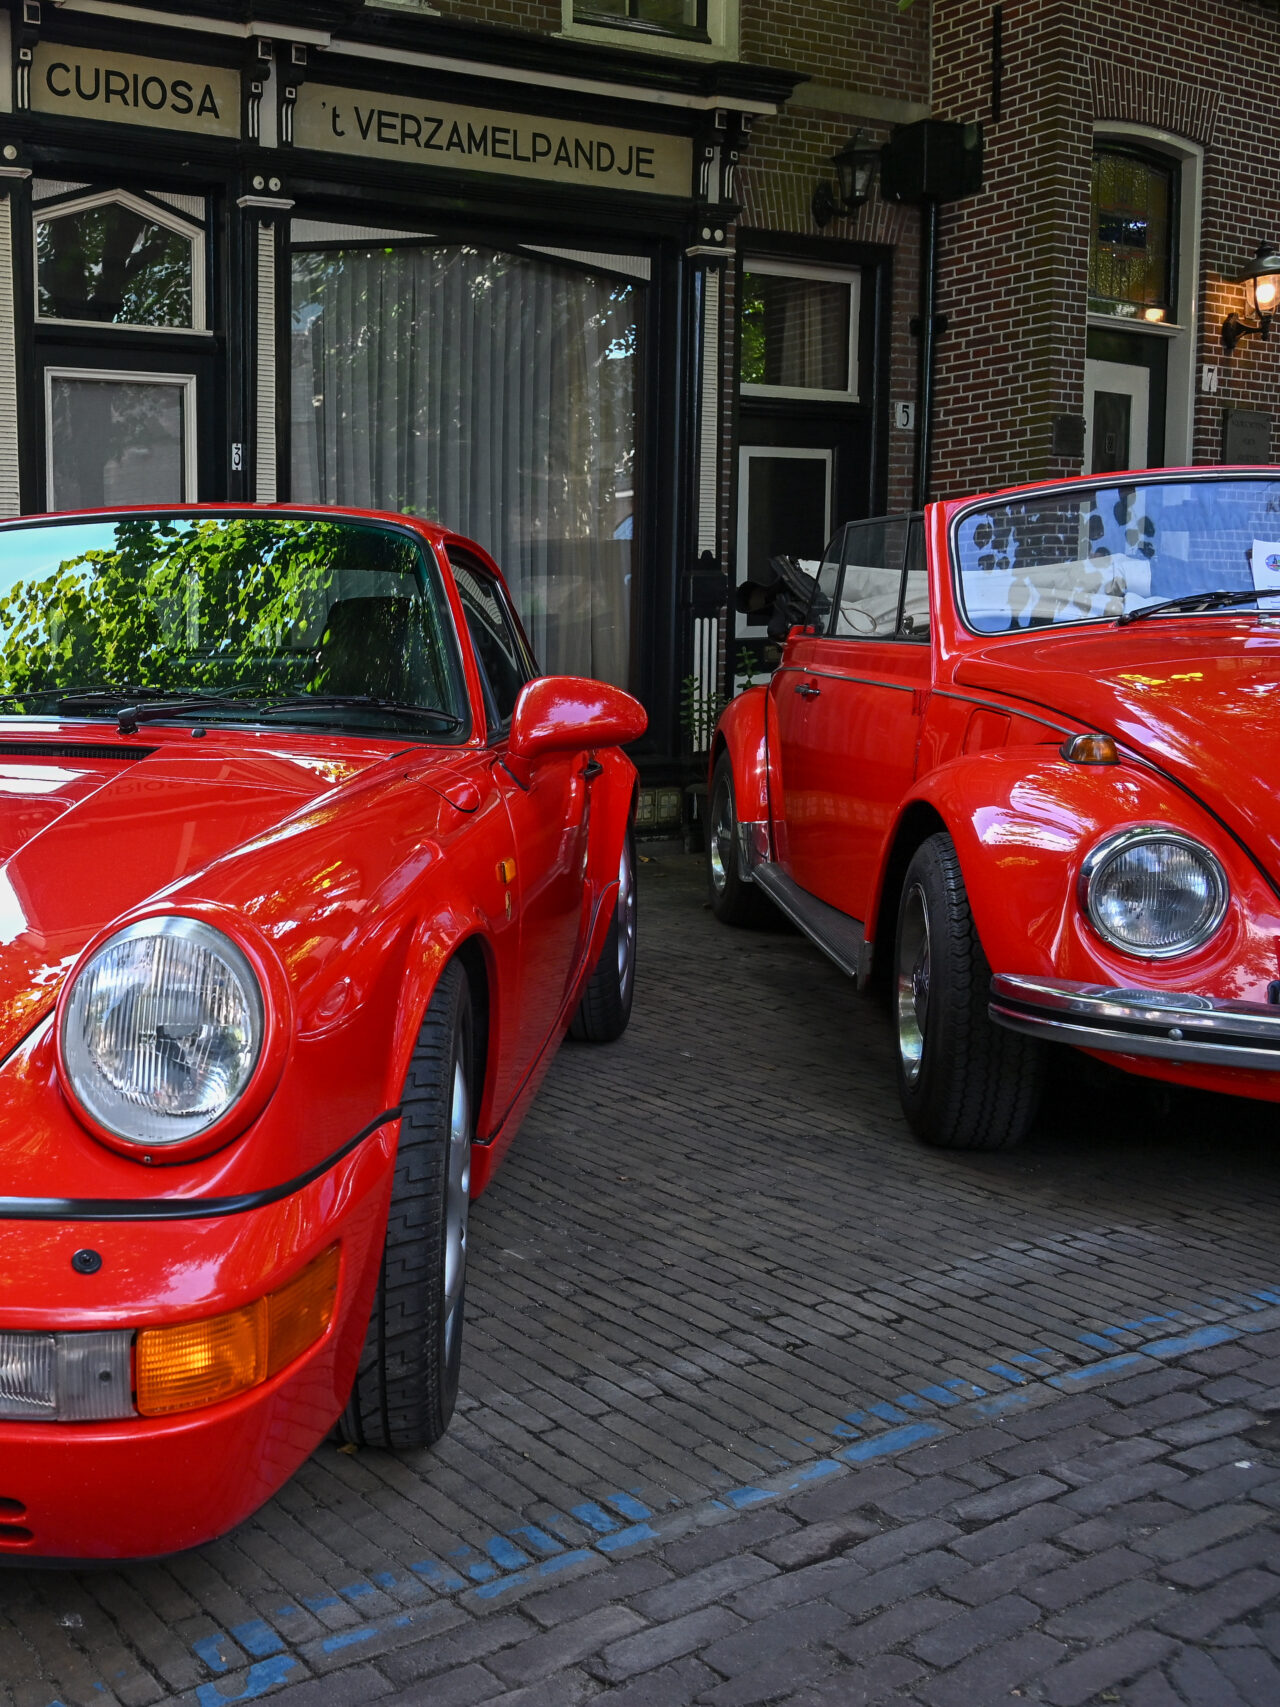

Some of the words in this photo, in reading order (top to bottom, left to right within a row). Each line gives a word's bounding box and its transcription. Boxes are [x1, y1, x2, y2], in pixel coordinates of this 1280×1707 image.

[46, 62, 220, 119] CURIOSA
[320, 101, 345, 137] 't
[353, 105, 655, 179] VERZAMELPANDJE
[1207, 367, 1215, 392] 7
[902, 404, 910, 427] 5
[233, 446, 241, 466] 3
